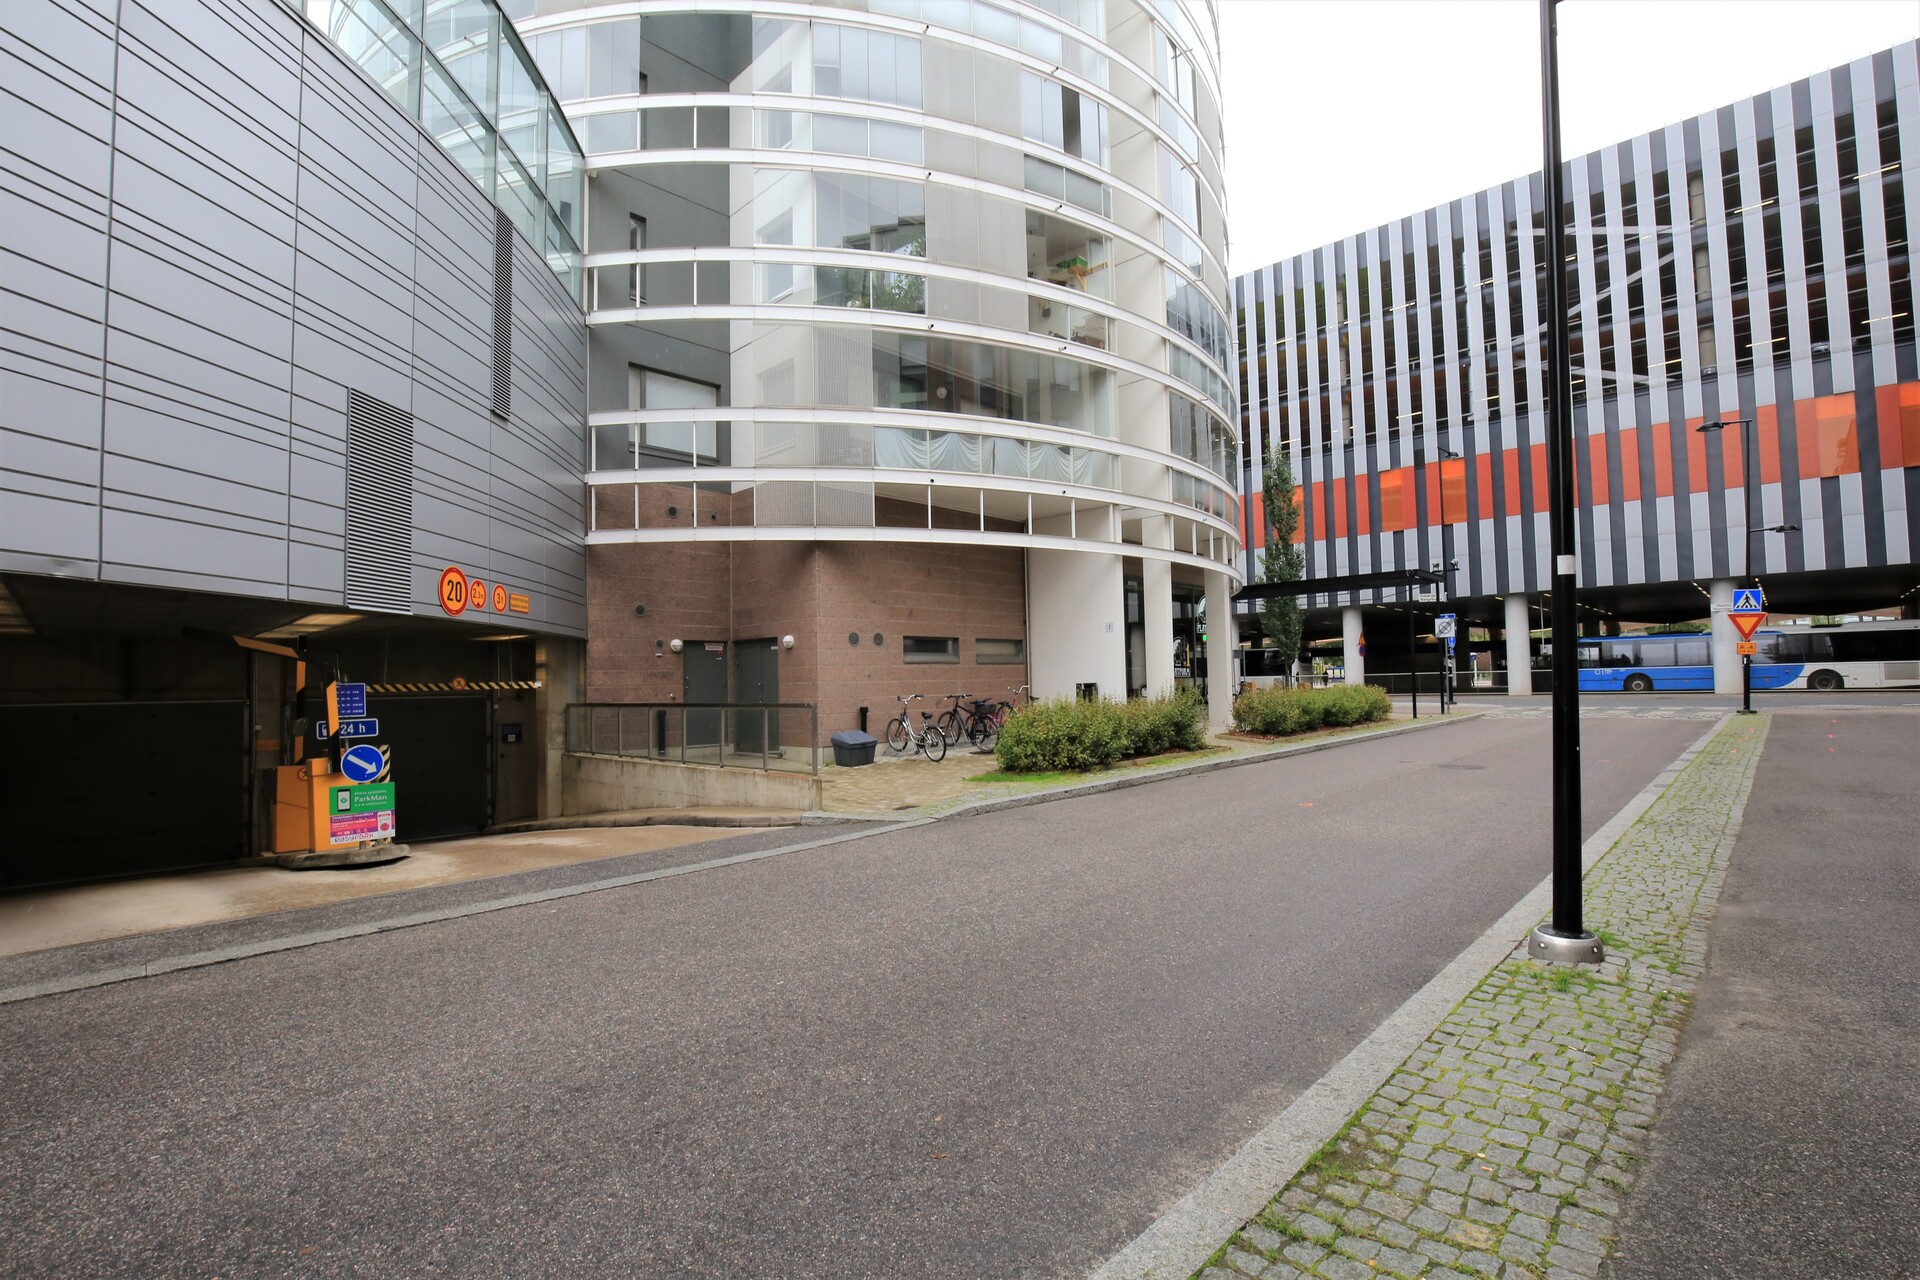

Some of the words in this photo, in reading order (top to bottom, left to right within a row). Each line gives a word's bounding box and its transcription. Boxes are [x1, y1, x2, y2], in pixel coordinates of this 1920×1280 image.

[447, 580, 462, 603] 20
[340, 724, 354, 735] 24
[359, 723, 366, 733] h
[354, 795, 388, 803] ParkMan
